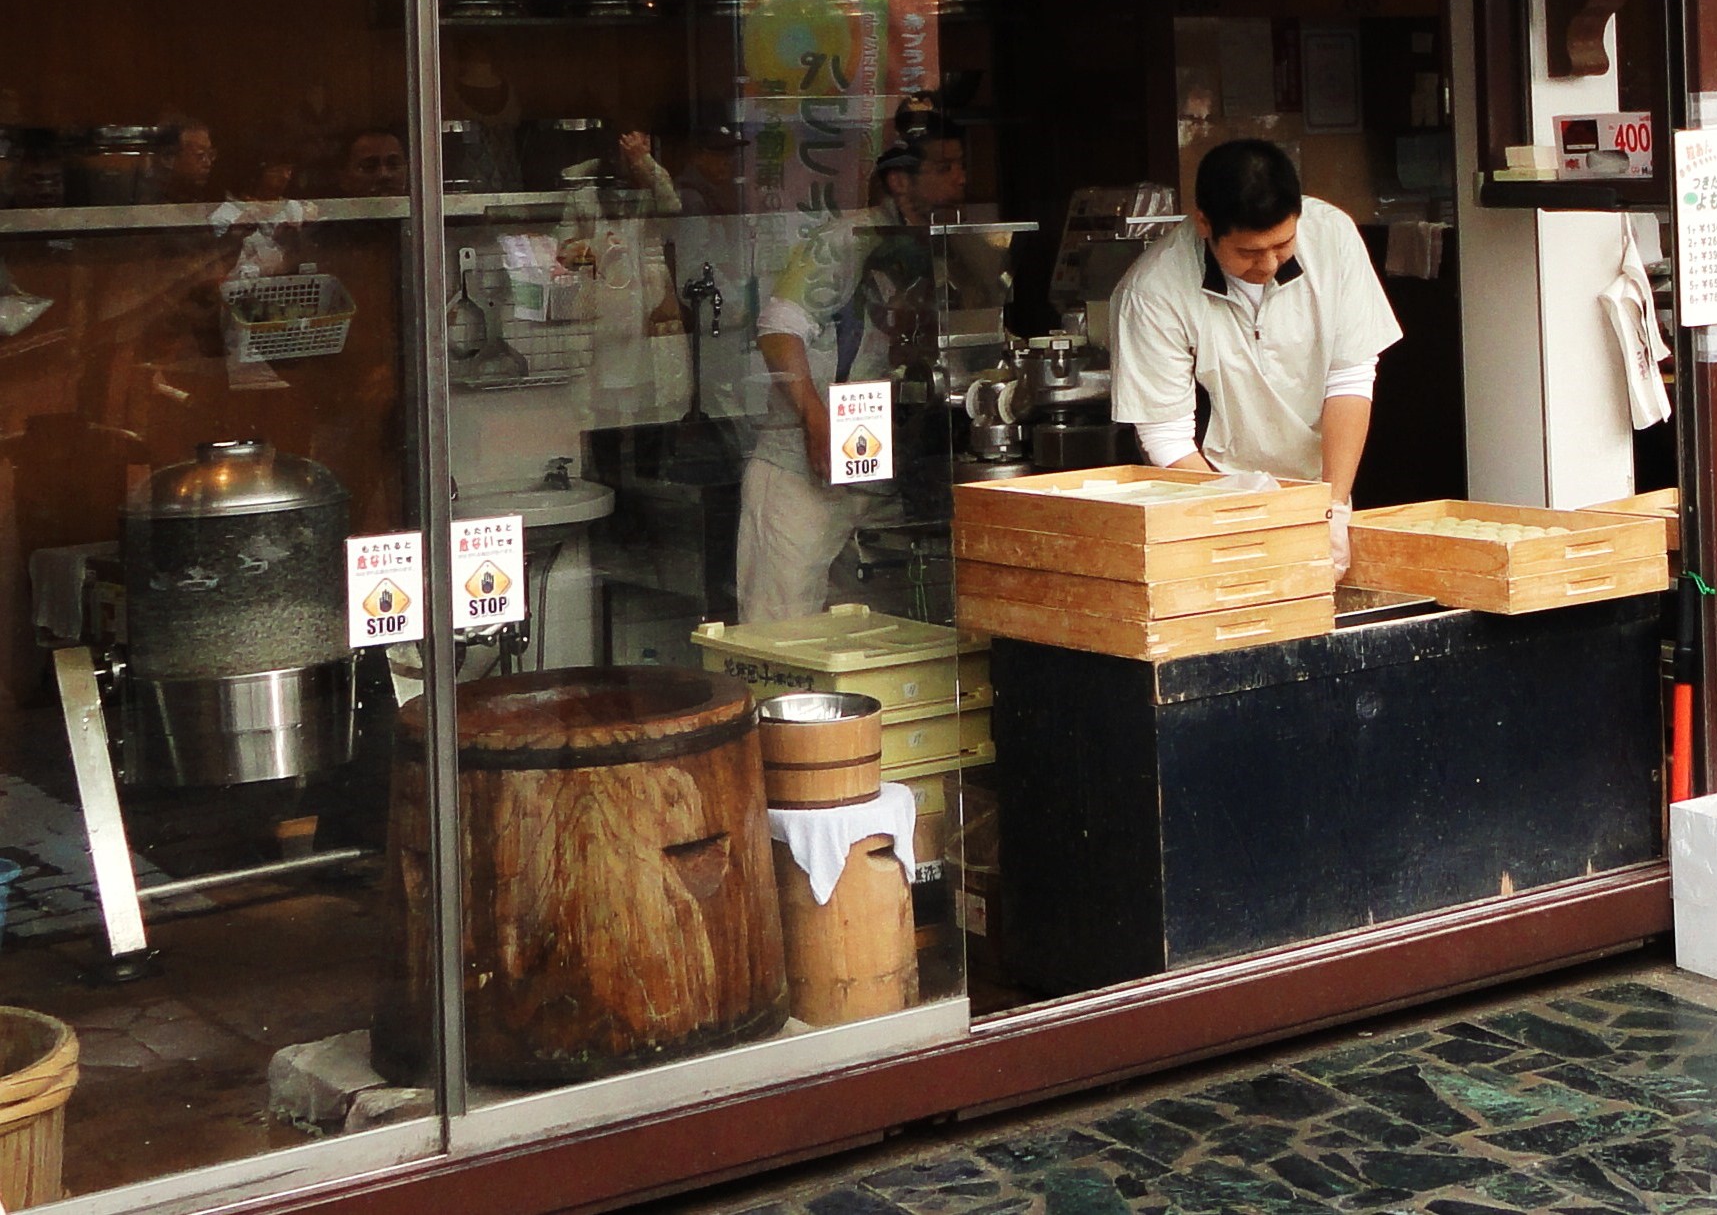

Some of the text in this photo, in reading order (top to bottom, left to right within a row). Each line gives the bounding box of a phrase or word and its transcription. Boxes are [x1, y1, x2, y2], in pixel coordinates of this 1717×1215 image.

[1614, 123, 1650, 153] 400
[841, 392, 883, 402] もたれると
[838, 402, 883, 416] 危ないです
[846, 459, 878, 476] STOP
[464, 524, 512, 536] もたれると
[362, 541, 412, 554] もたれると
[459, 536, 513, 552] 危ないです
[357, 554, 412, 570] 危ないです
[469, 597, 507, 616] STOP
[367, 615, 406, 635] STOP
